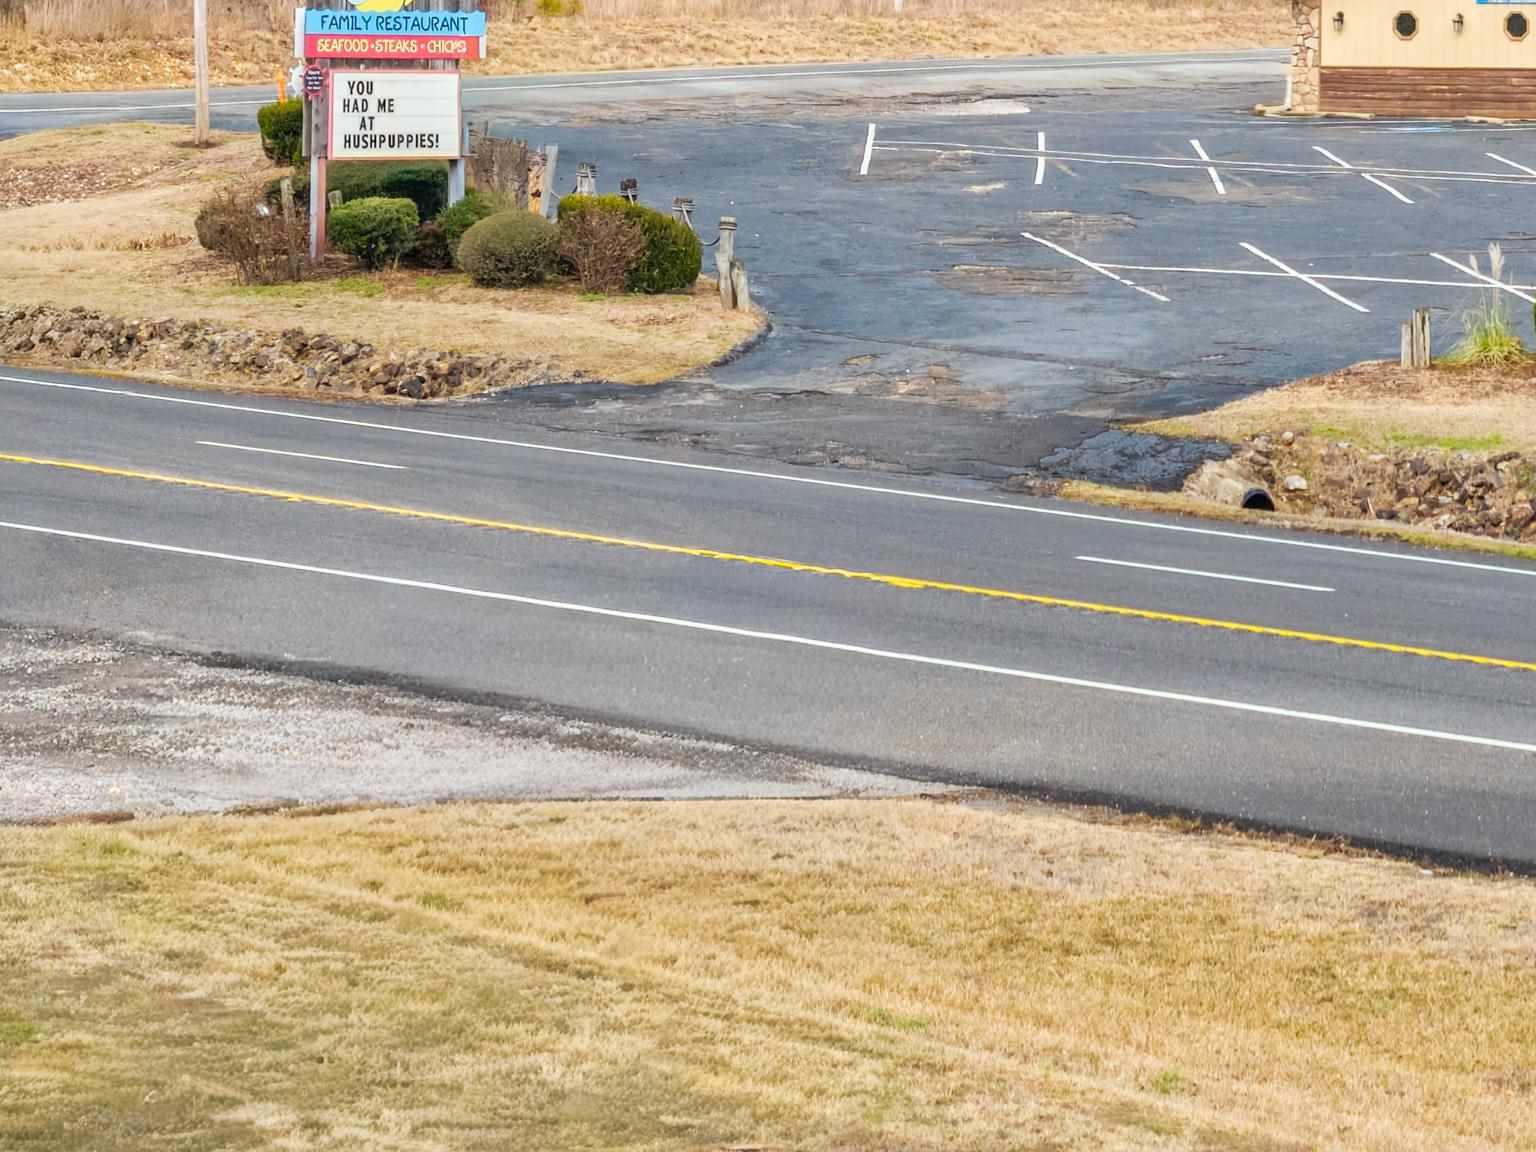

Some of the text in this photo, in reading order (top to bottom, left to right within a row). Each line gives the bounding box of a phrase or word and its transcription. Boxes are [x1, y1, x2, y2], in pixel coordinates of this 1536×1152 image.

[321, 14, 469, 35] FAMILY RESTAURANT
[316, 38, 369, 53] SEAFOOD
[375, 39, 418, 54] STEAKS
[348, 80, 374, 96] YOU
[343, 98, 395, 113] HAD ME
[359, 116, 375, 131] AT
[343, 133, 440, 149] HUSHPUPPIES!
